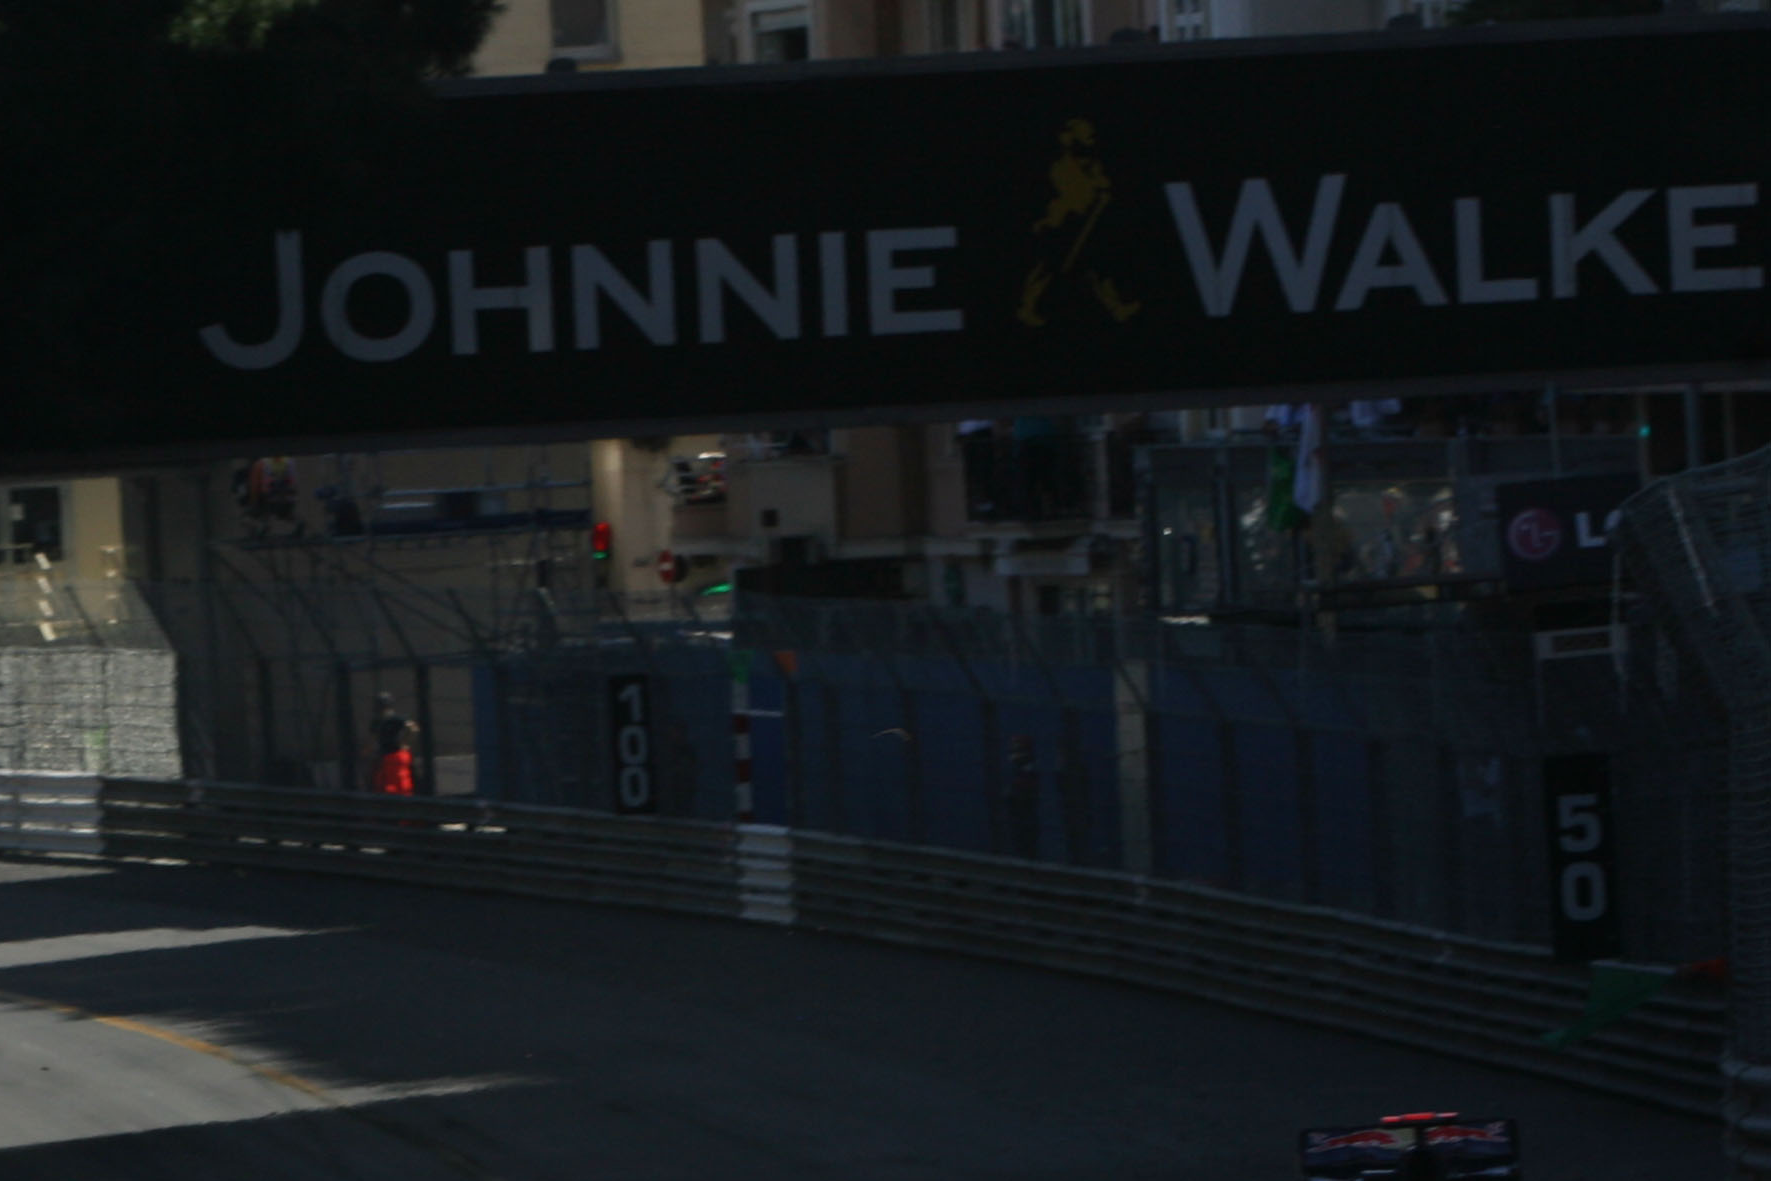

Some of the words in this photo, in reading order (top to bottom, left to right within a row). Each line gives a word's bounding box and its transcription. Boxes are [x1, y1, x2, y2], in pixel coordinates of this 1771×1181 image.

[197, 226, 965, 371] JOHNNIE
[616, 682, 651, 809] 100
[1555, 792, 1607, 921] 50
